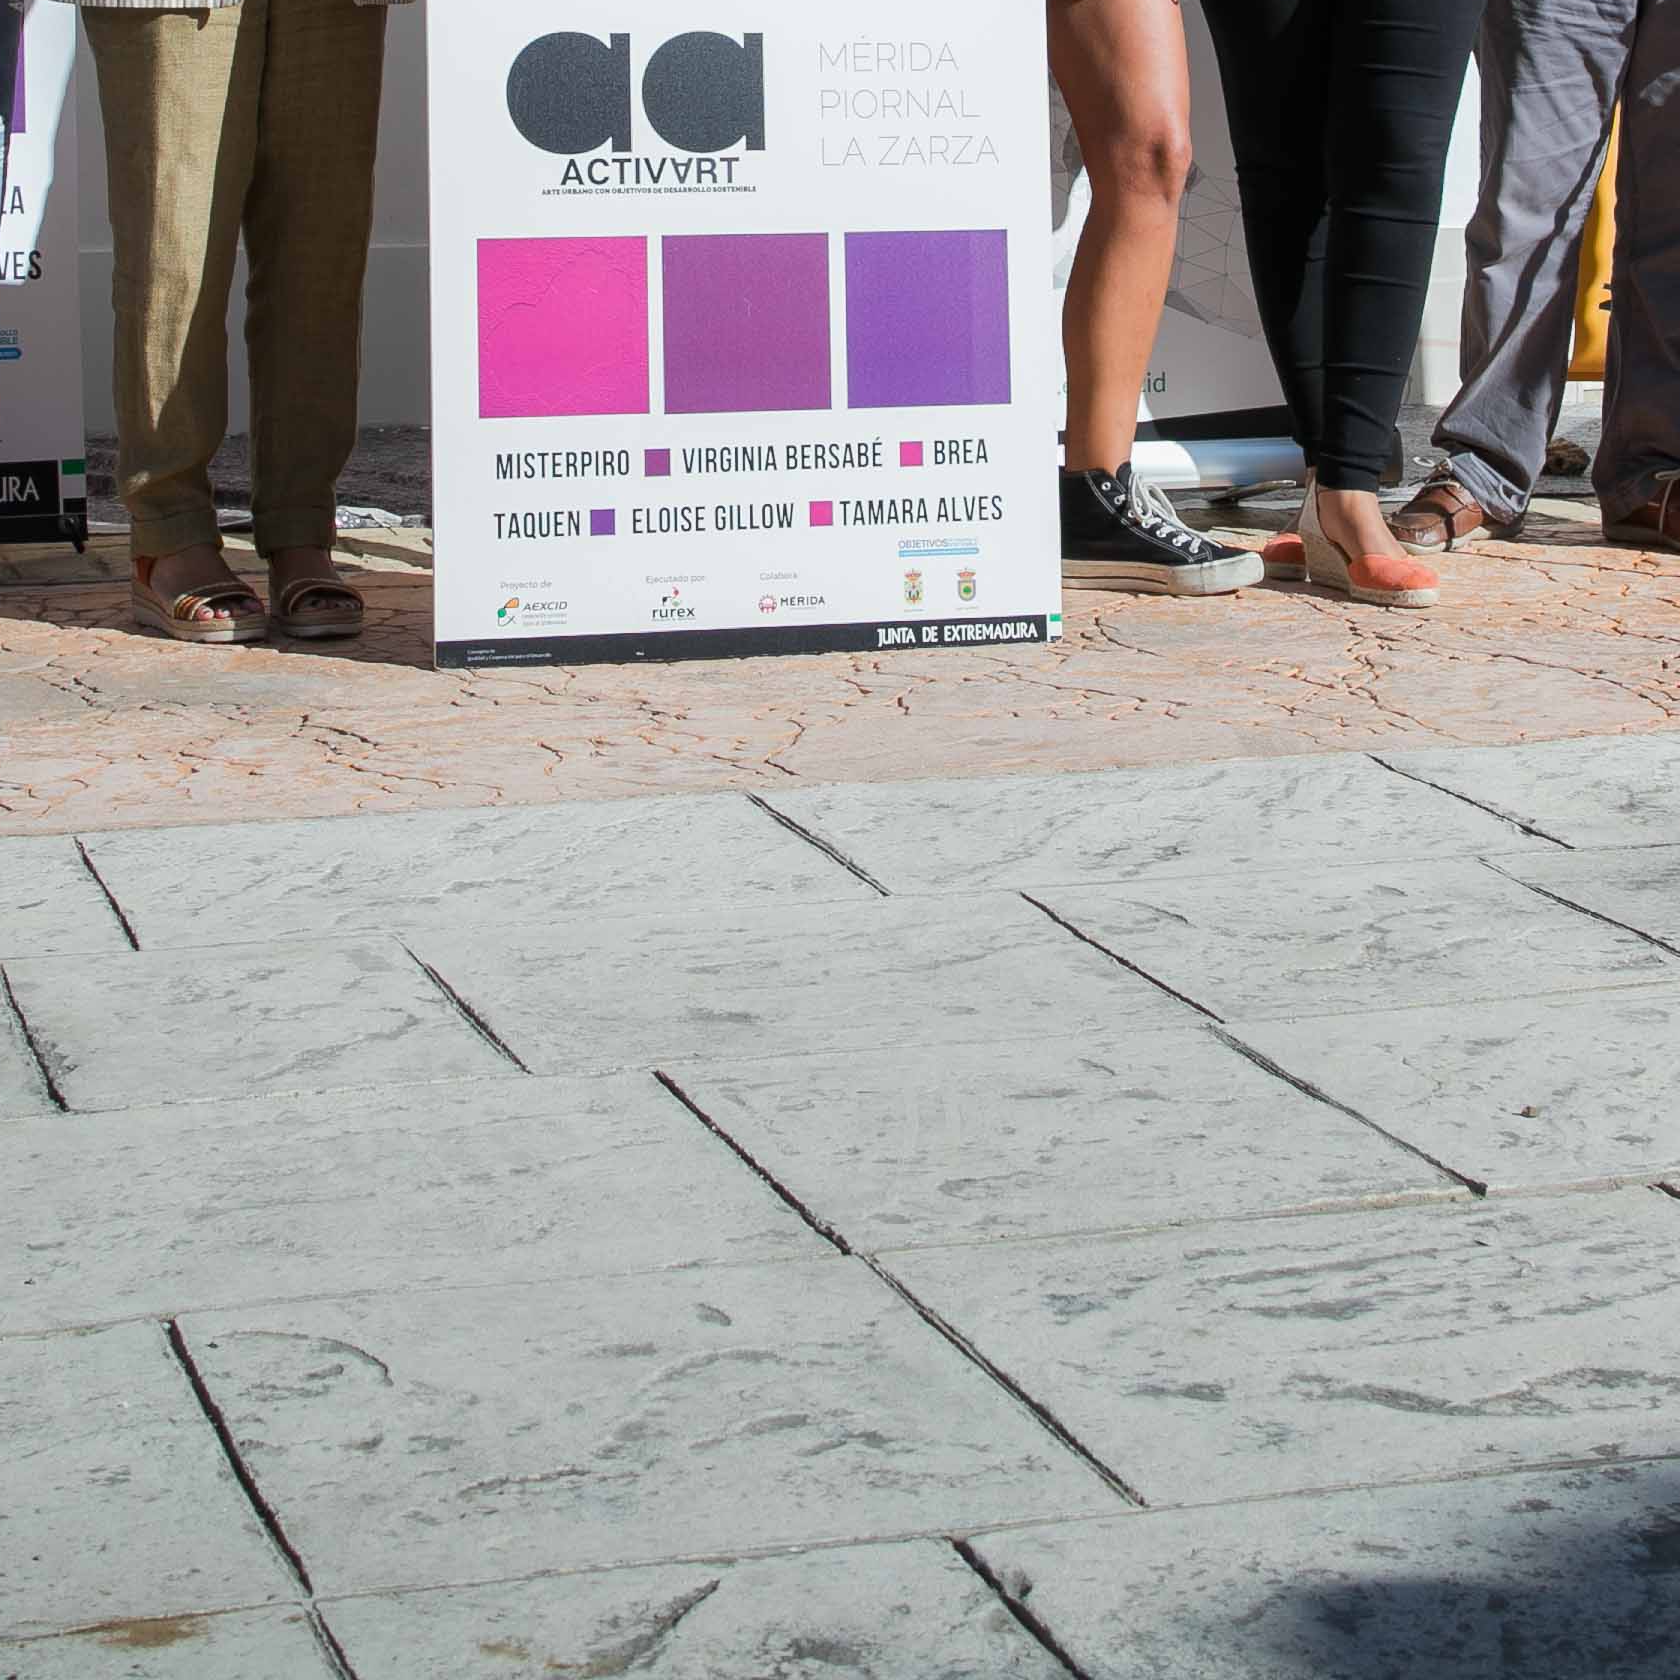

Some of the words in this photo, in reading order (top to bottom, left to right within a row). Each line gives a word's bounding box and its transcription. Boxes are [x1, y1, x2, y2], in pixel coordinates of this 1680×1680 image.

[819, 34, 960, 73] MÉRIDA
[819, 88, 982, 121] PIORNAL
[819, 136, 866, 167] LA
[878, 135, 1001, 167] ZARZA
[494, 449, 631, 481] MISTERPIRO
[682, 443, 778, 474] VIRGINIA
[785, 436, 883, 470] BERSABÉ
[933, 438, 989, 466] BREA
[493, 509, 582, 541] TAQUEN
[631, 505, 707, 535] ELOISE
[714, 502, 795, 532] GILLOW
[839, 497, 930, 527] TAMARA
[936, 494, 1004, 522] ALVES
[897, 538, 948, 549] OBJETIVOS
[499, 580, 539, 591] Proyecto
[645, 574, 689, 585] Ejecutado
[522, 600, 568, 612] AEXCID
[652, 607, 696, 619] rurex
[877, 626, 916, 648] JUNTA
[921, 625, 938, 643] DE
[943, 622, 1039, 642] EXTREMADURA
